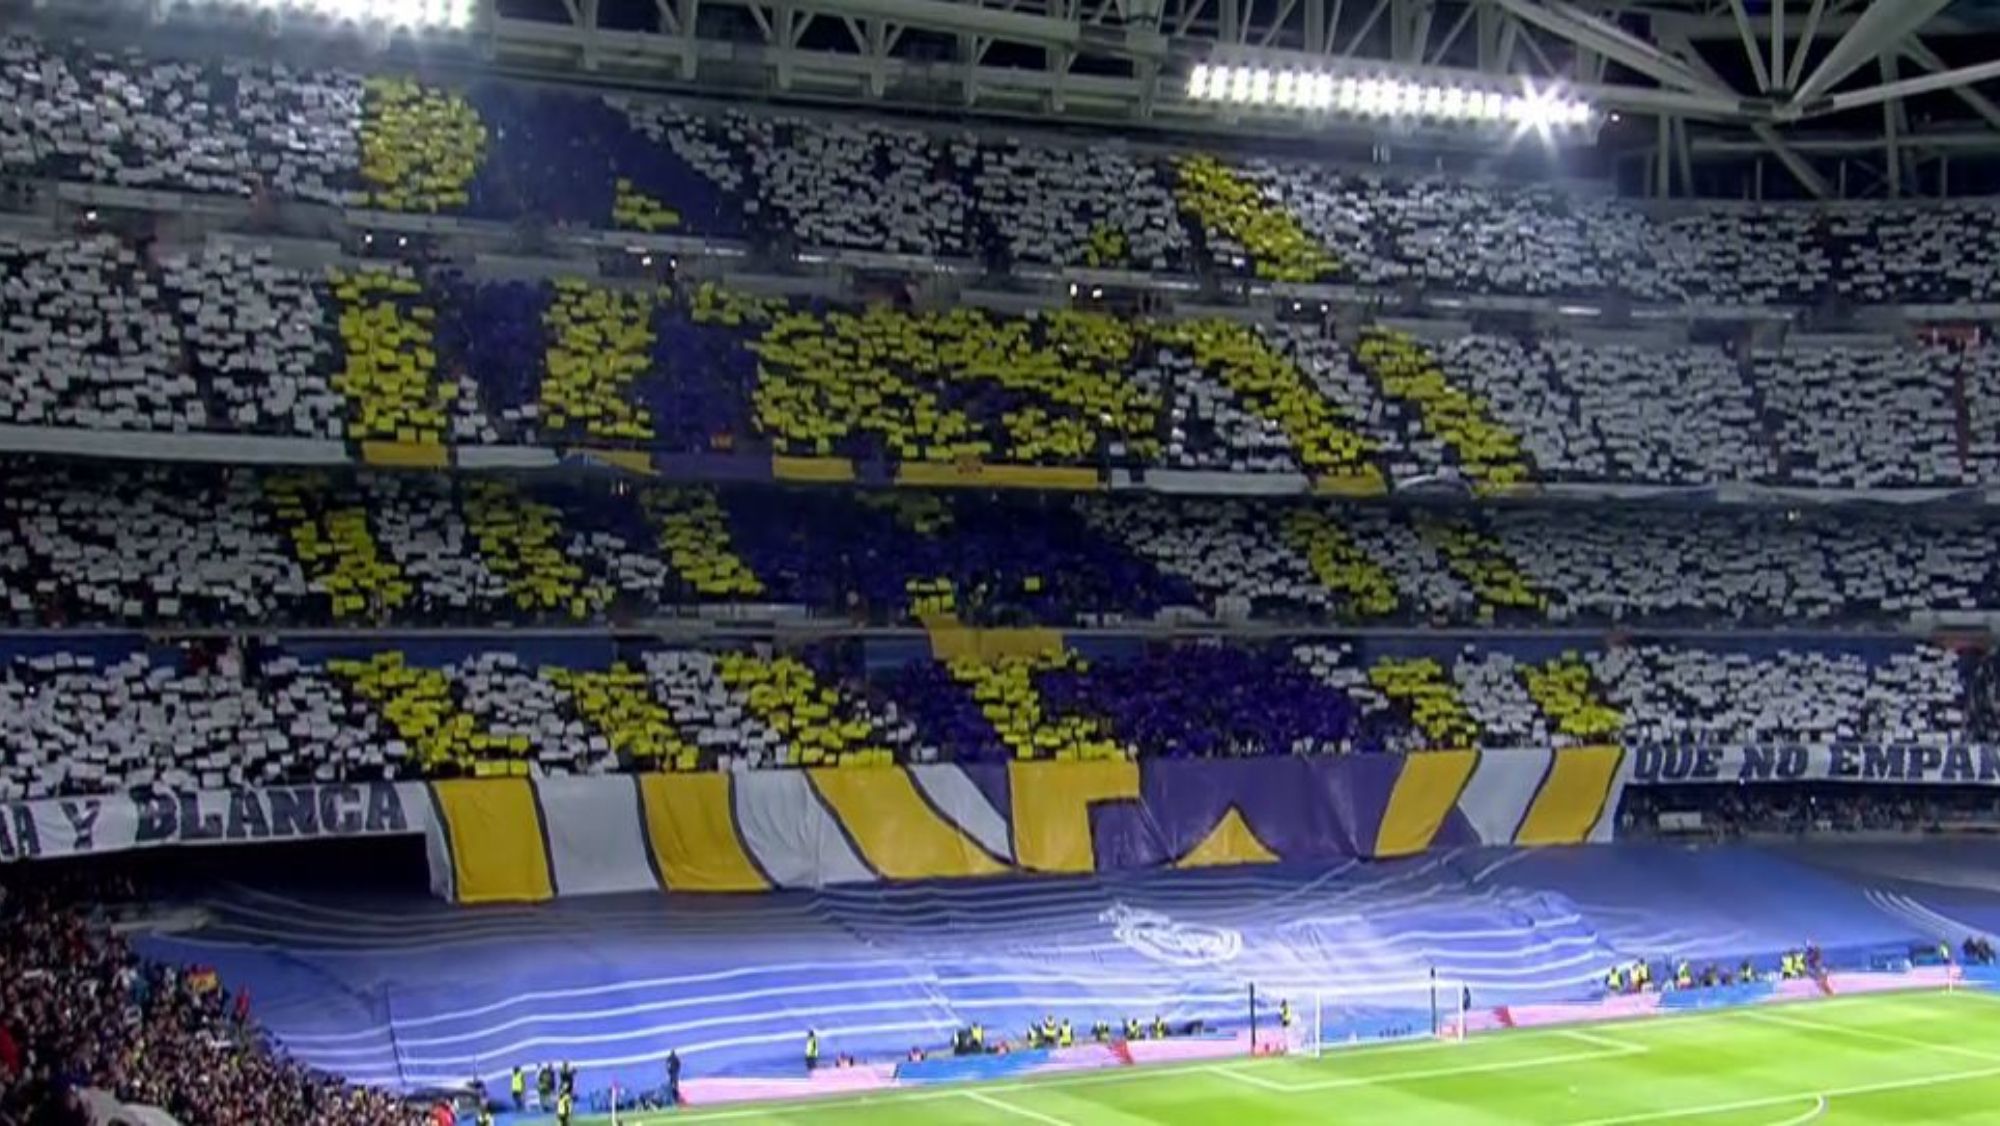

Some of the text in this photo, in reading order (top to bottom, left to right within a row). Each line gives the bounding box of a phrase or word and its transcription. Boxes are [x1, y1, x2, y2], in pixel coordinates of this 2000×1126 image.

[1633, 744, 1724, 780] QUE
[1740, 745, 1809, 780] NO
[59, 799, 101, 850] Y
[130, 784, 407, 842] BLANCA
